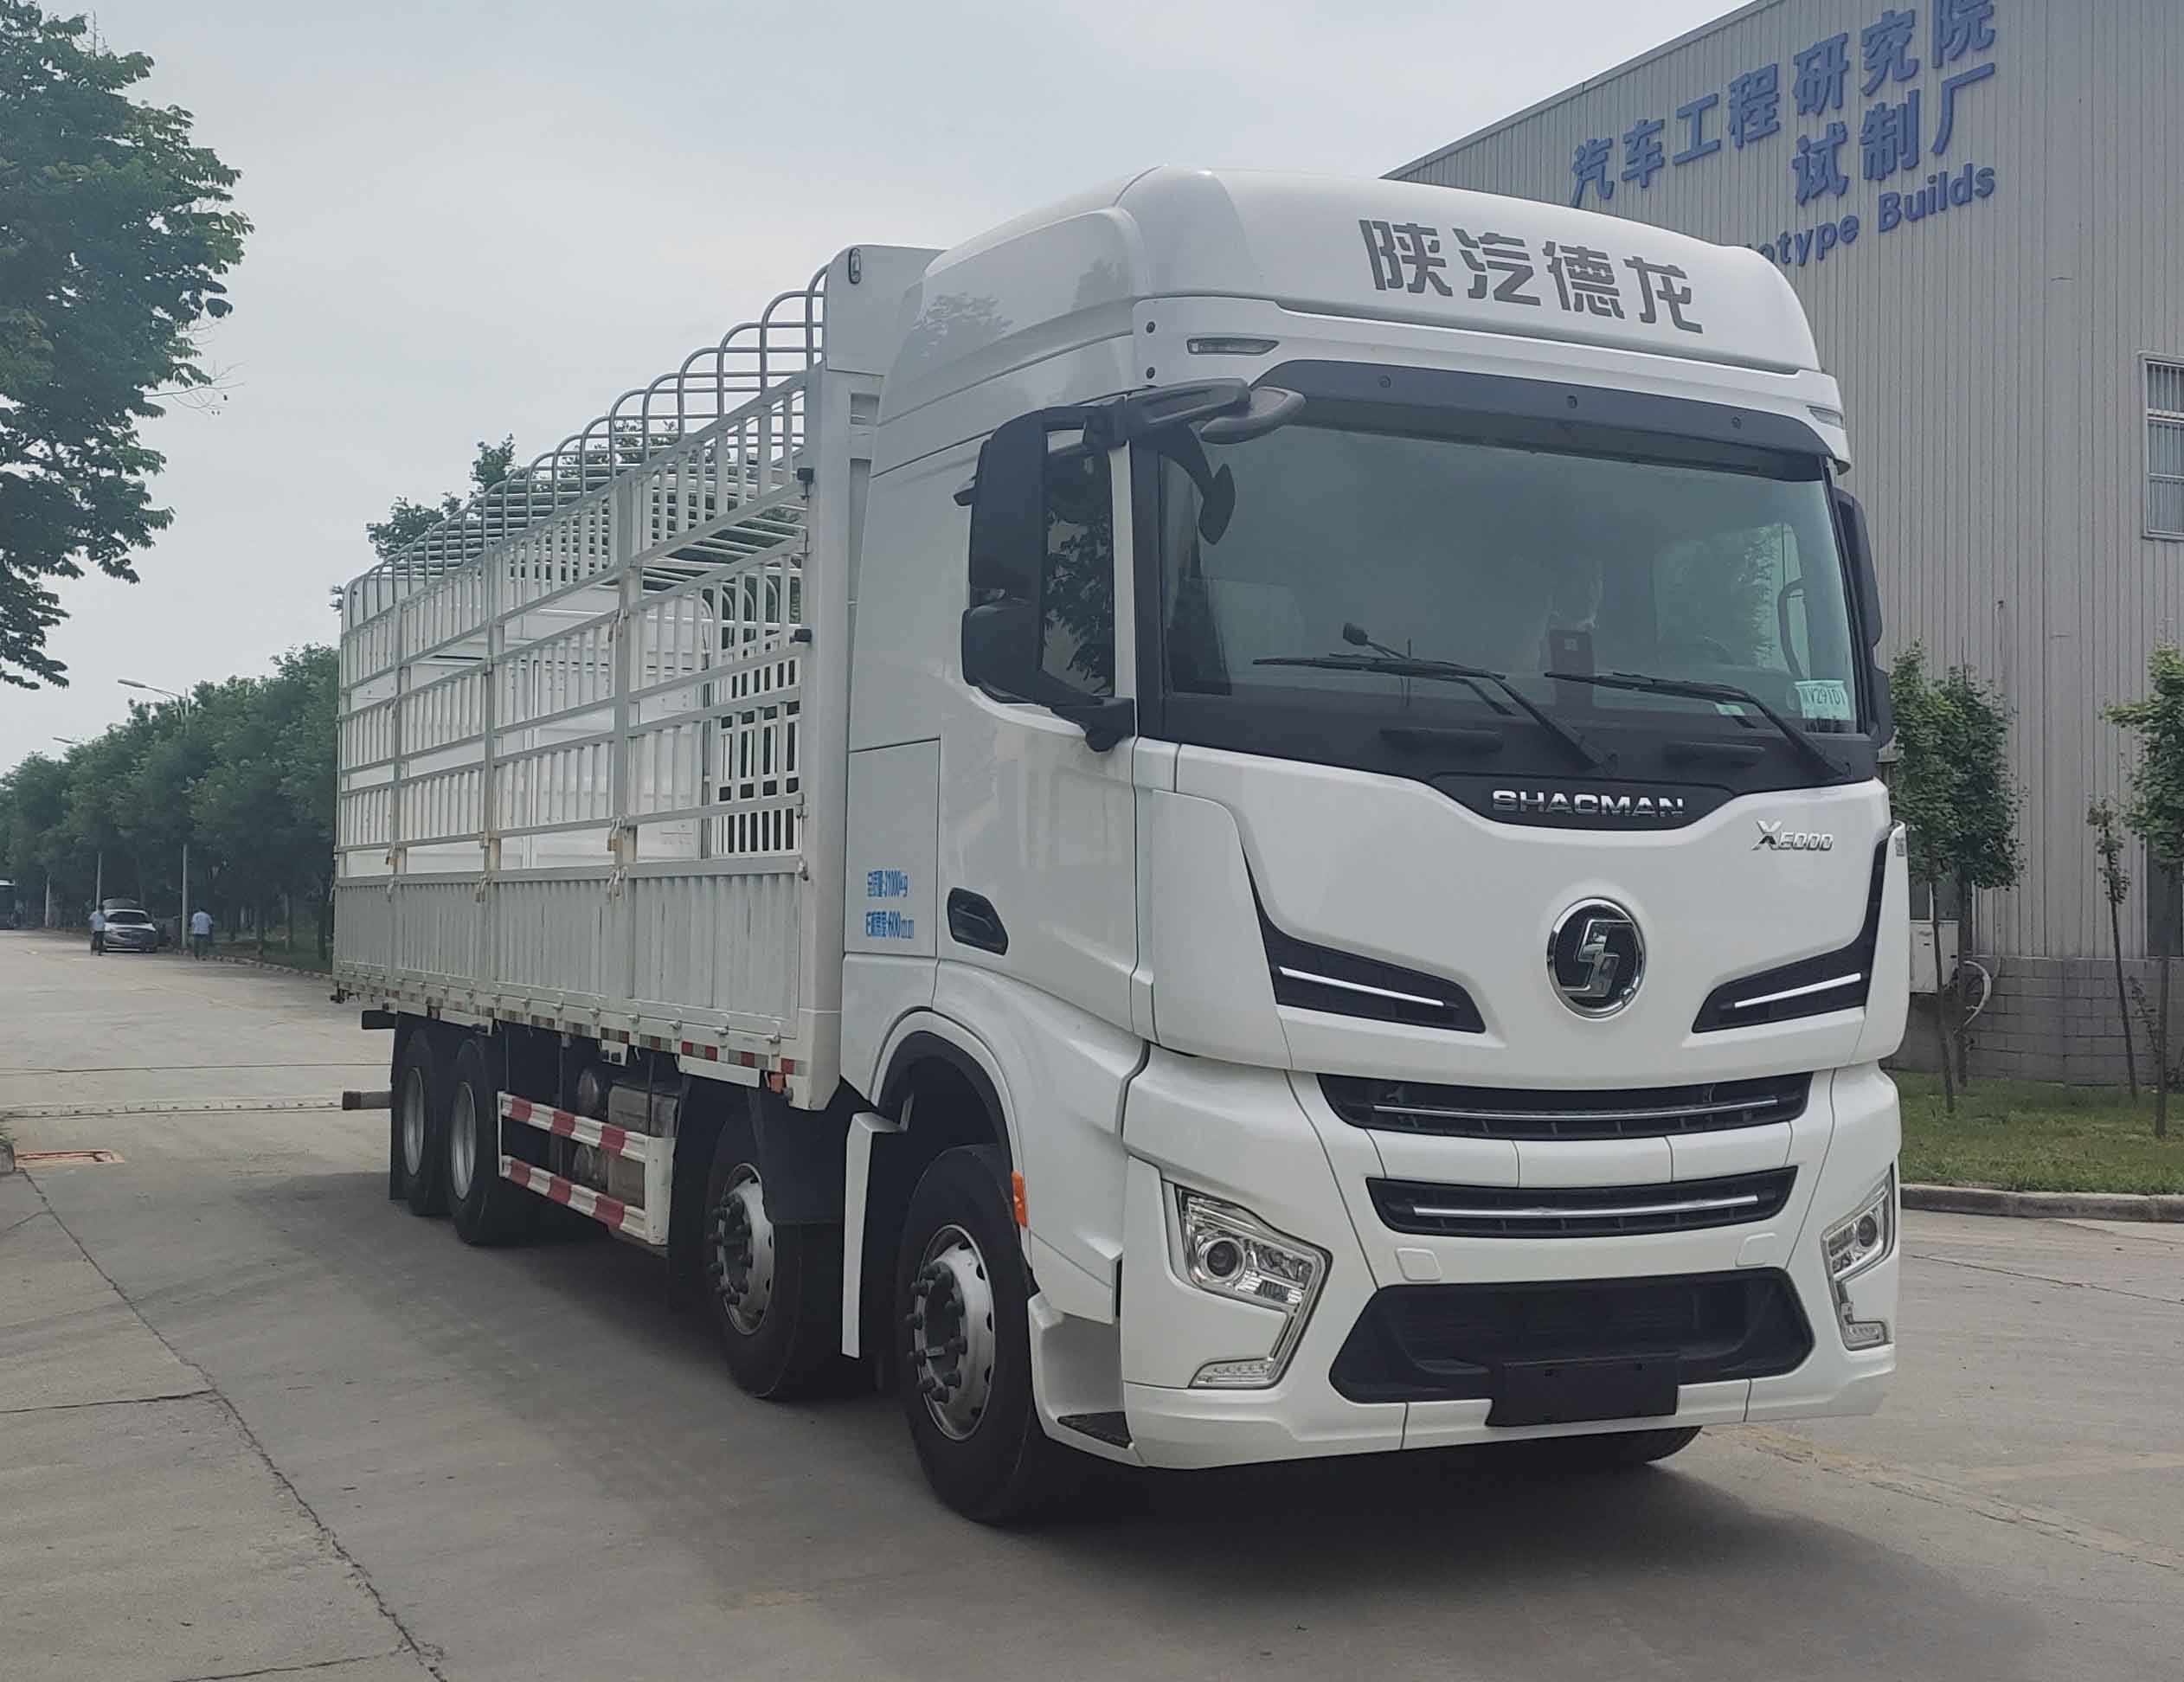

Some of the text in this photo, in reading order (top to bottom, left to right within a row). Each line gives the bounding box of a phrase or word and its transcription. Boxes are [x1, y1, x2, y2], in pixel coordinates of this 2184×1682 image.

[1569, 0, 1995, 209] 汽车工程研究院
[1791, 62, 1995, 207] 试制厂
[1878, 162, 1995, 234] Builds
[1359, 218, 1704, 334] 陕汽德龙
[1492, 789, 1684, 818] SHACMAN
